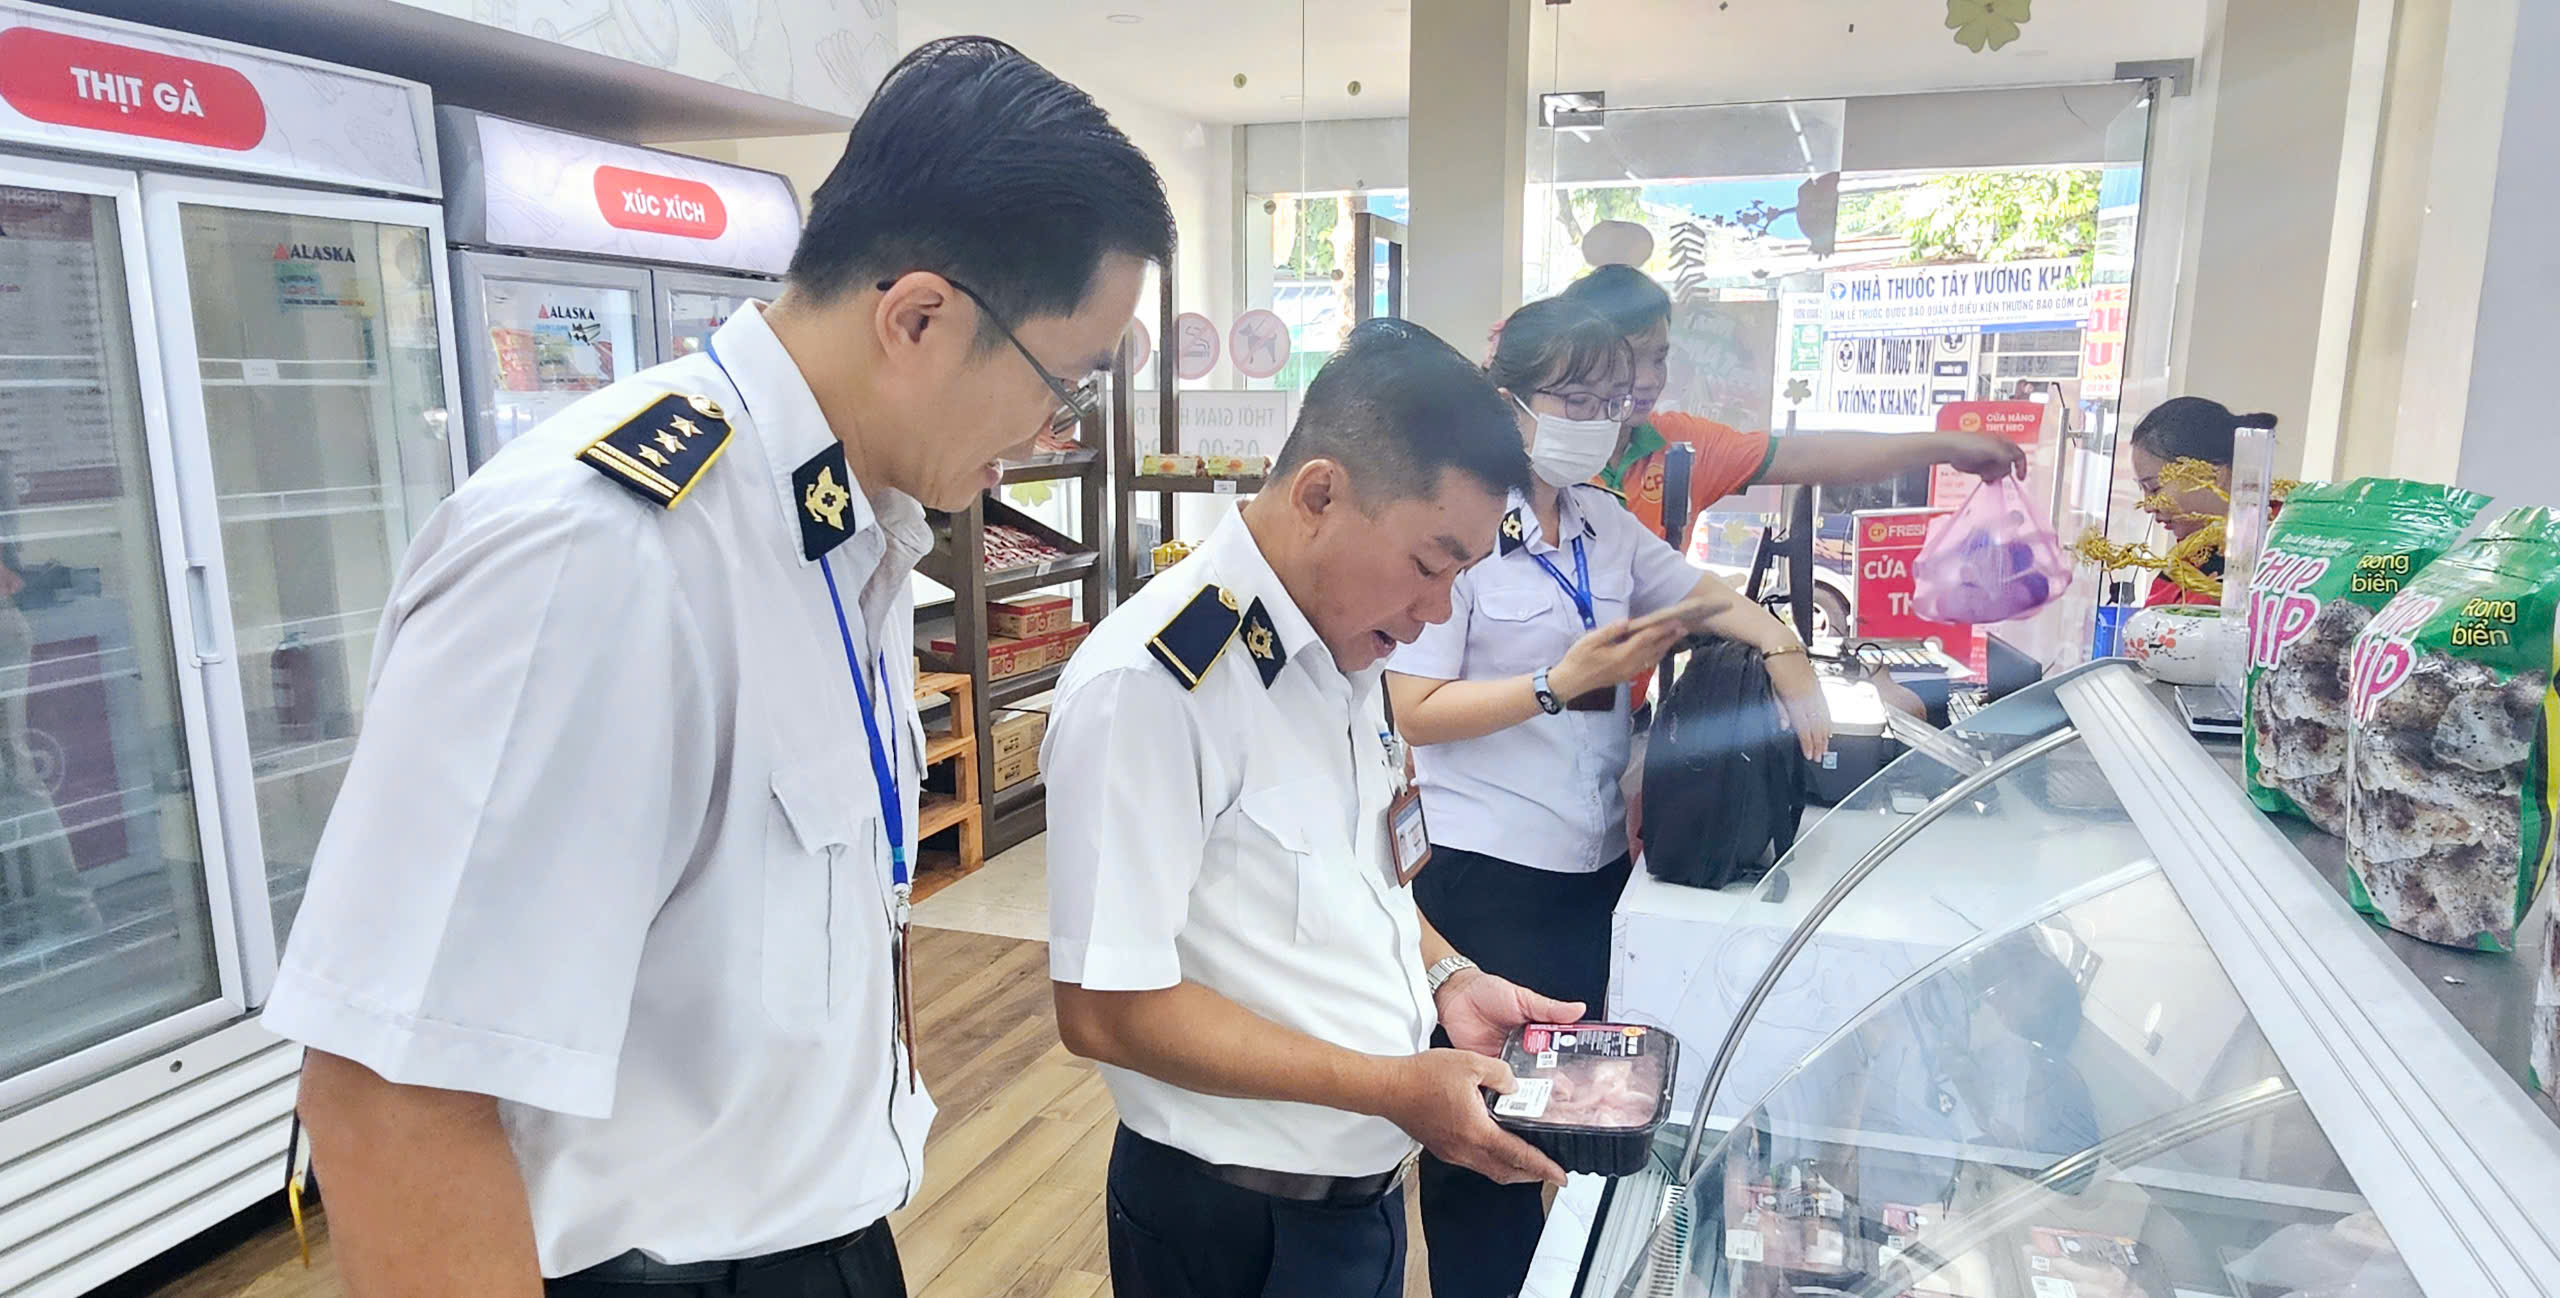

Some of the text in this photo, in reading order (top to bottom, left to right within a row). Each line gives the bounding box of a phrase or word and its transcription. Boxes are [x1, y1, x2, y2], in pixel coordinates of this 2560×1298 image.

[70, 66, 205, 118] THỊT GÀ
[622, 187, 706, 224] XÚC XÍCH
[290, 243, 356, 263] ALASKA
[1852, 273, 1881, 302] NHÀ
[1888, 267, 1935, 300] THUỐC
[1942, 269, 1969, 297] TÂY
[1975, 265, 2032, 295] VƯƠNG
[550, 305, 595, 321] ALASKA
[1879, 388, 1917, 416] KHANG
[1863, 554, 1907, 580] CỬA
[2355, 554, 2410, 575] Rong
[2351, 570, 2399, 592] biển
[2461, 597, 2517, 624] Rong
[2451, 619, 2509, 645] biển
